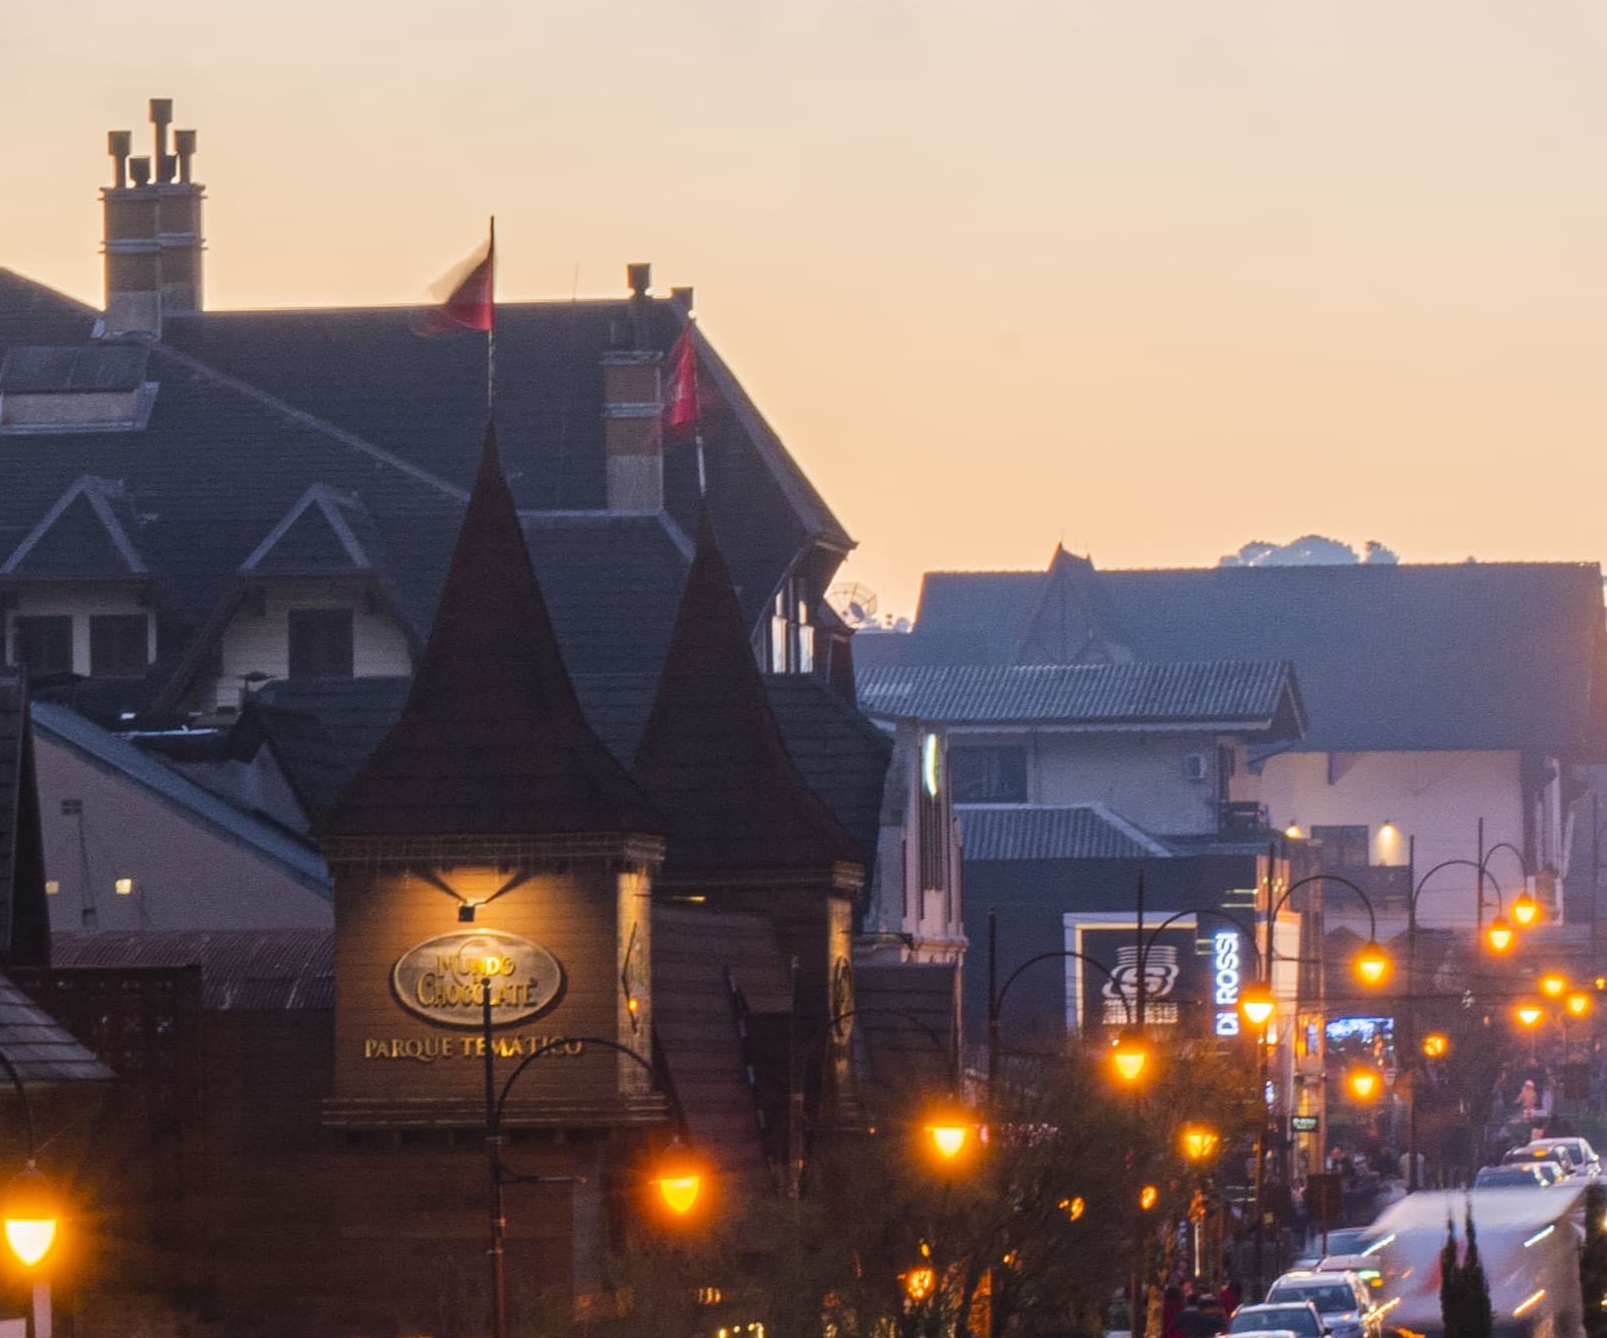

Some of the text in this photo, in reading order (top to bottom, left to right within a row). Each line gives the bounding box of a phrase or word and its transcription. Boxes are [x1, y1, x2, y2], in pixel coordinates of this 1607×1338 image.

[437, 956, 515, 977] MUNDO
[1215, 932, 1239, 1005] ROSSI
[365, 1034, 583, 1061] PARQUE TEMÁTICO
